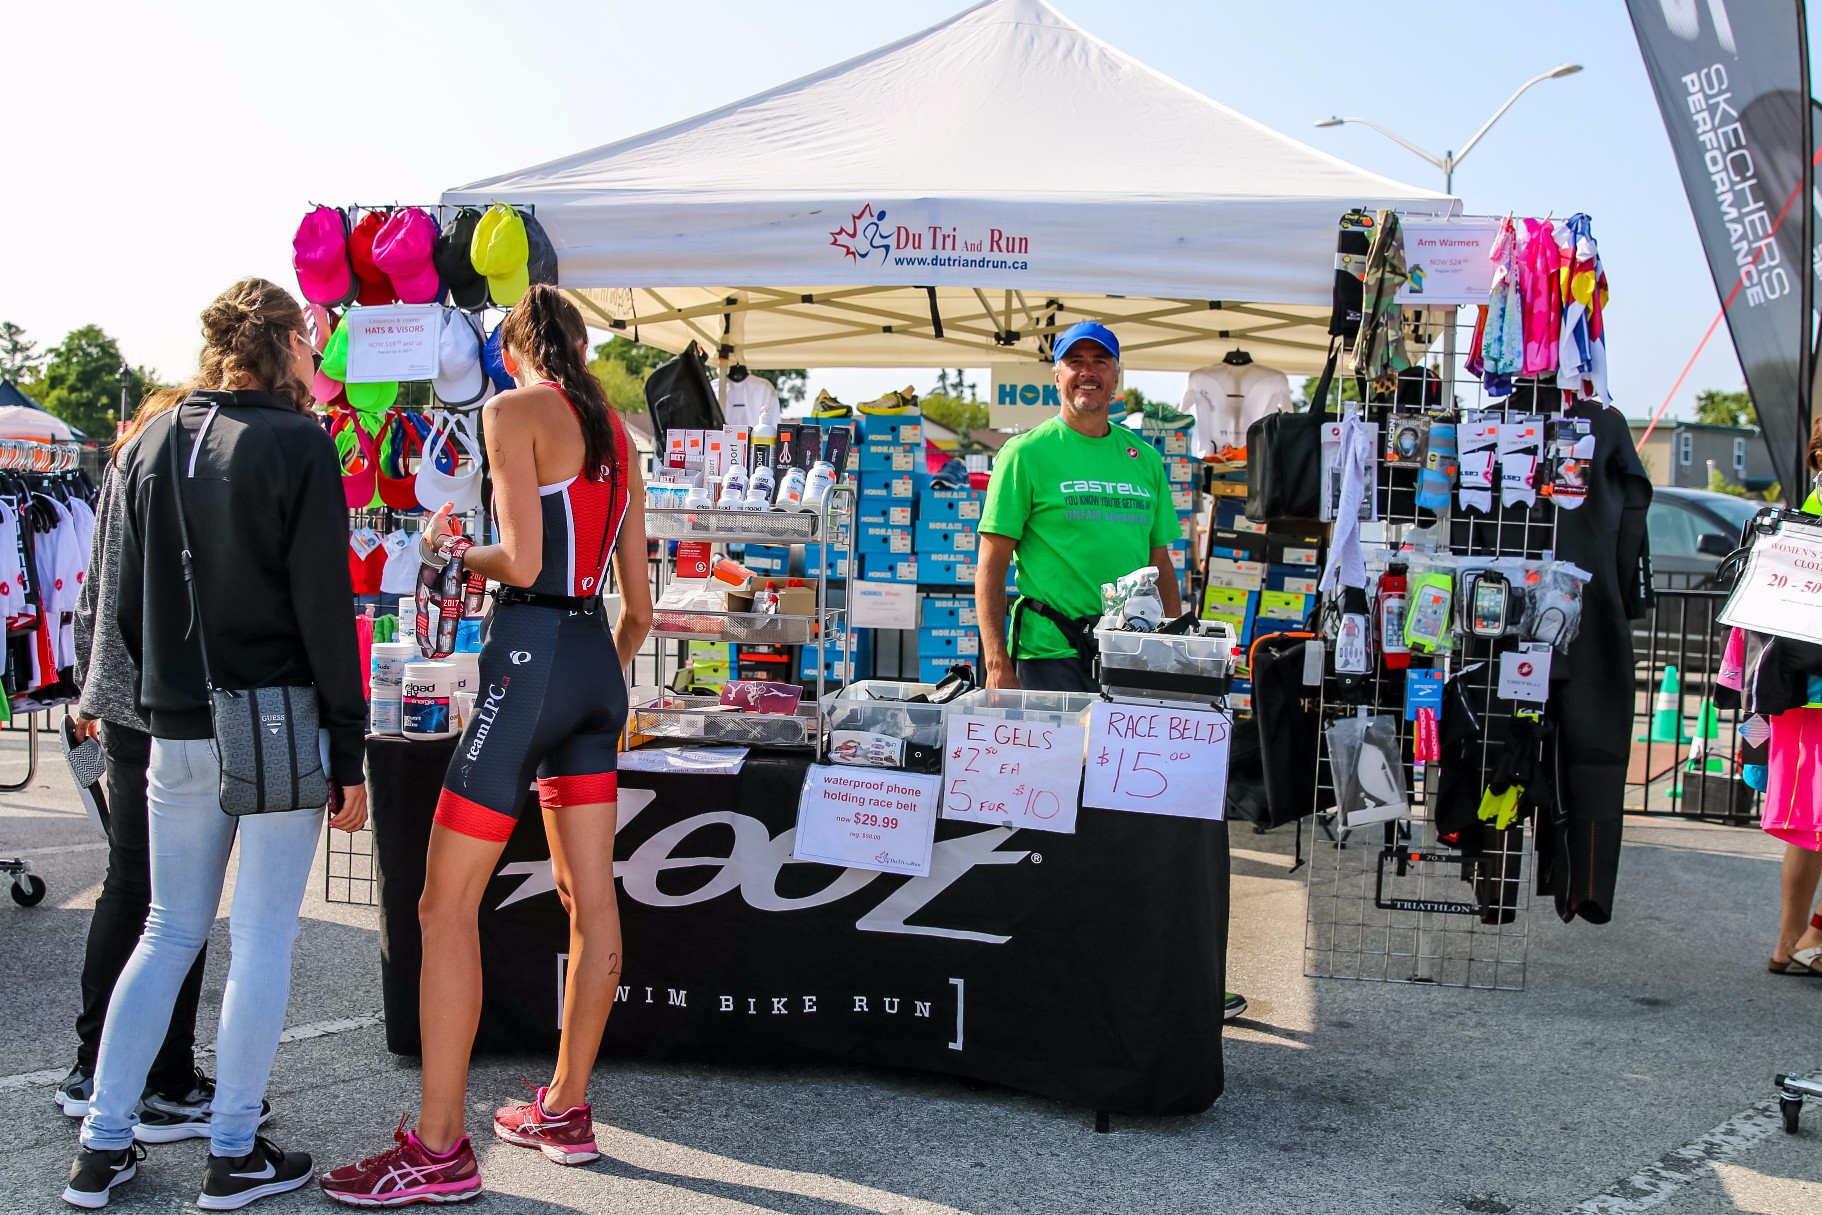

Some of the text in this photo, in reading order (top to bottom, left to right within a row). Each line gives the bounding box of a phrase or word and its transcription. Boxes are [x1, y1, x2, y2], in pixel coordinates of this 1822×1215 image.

[1681, 72, 1765, 307] PERFORMANCE
[1700, 63, 1790, 300] SKECHERS
[895, 226, 1029, 254] Du Tri And Run
[1417, 239, 1479, 247] Arm Warmers
[894, 254, 1028, 270] www.dutriandrun.ca
[365, 325, 424, 335] HATS & VISORS
[998, 384, 1061, 406] HOK
[1387, 418, 1397, 454] EACON
[670, 453, 685, 461] BEET
[1063, 495, 1078, 506] YOU
[1079, 494, 1099, 506] KNOW
[1771, 542, 1818, 560] WOMEN'S
[1767, 573, 1788, 588] 20
[443, 599, 459, 607] 2017
[262, 714, 285, 722] GUESS
[967, 722, 1053, 750] E GELS
[1108, 711, 1228, 744] RACE BELTS
[999, 763, 1020, 775] EA
[823, 775, 921, 797] waterproof phone
[823, 790, 917, 812] holding race belt
[948, 779, 1060, 820] 5 FOR $10
[836, 812, 899, 830] now $29.99
[1426, 854, 1447, 862] 70.3
[1394, 900, 1472, 914] TRIATHLON
[613, 985, 932, 1018] WIM BIKE RUN
